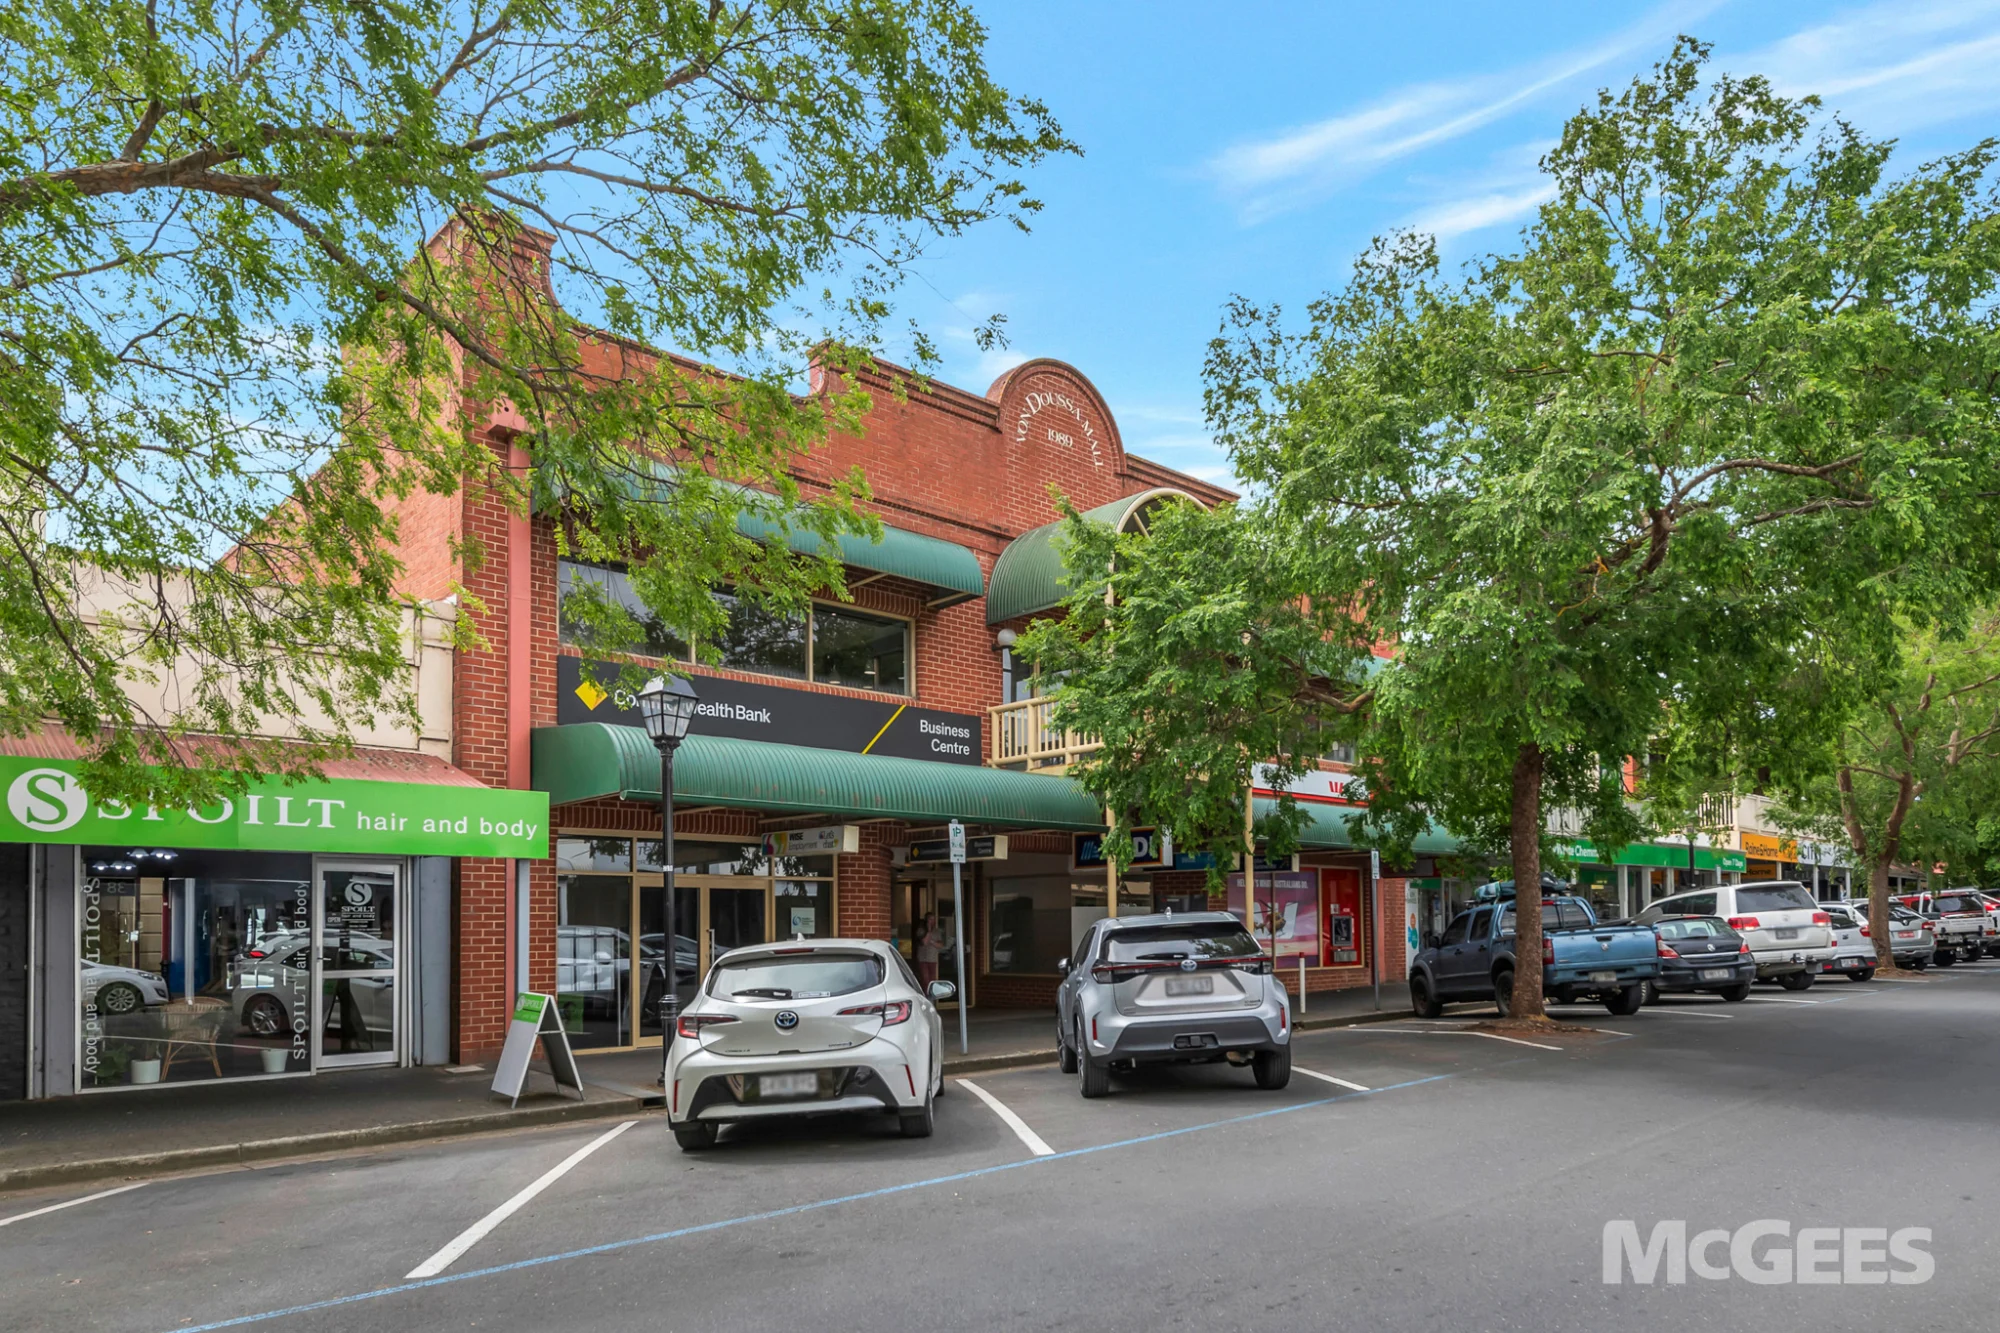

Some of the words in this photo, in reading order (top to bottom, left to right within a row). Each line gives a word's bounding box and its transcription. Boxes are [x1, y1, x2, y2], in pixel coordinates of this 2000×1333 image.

[1025, 392, 1081, 421] DOUSSA
[1081, 419, 1104, 473] MALL
[1047, 428, 1073, 448] 1989
[920, 719, 970, 738] Business
[931, 738, 970, 756] Centre
[26, 773, 69, 825] S
[357, 811, 408, 831] hair
[423, 816, 468, 834] and
[479, 817, 538, 840] body
[789, 832, 804, 841] WISE
[294, 881, 309, 915] body
[86, 877, 101, 964] SPOILT
[86, 1003, 101, 1030] and
[293, 981, 306, 1060] SPOILT
[83, 1036, 101, 1074] body
